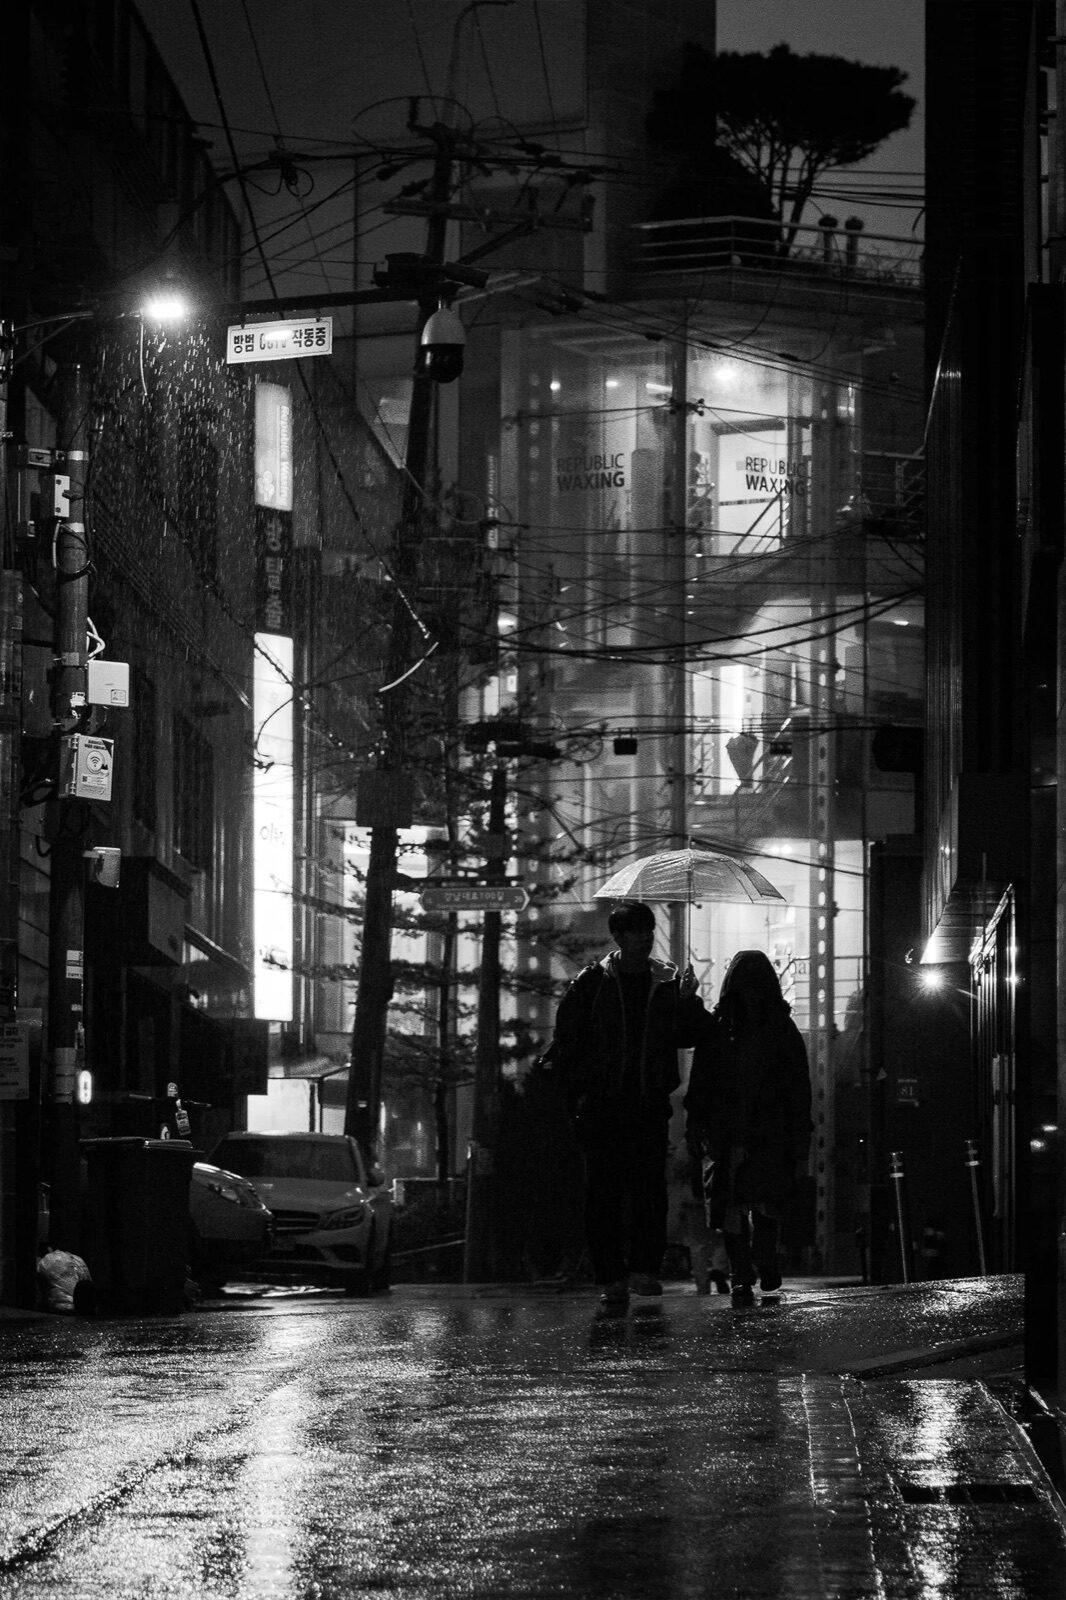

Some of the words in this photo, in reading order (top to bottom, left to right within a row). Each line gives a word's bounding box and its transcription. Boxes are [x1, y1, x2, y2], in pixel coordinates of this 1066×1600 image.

[233, 333, 255, 354] 방범
[292, 326, 326, 348] 작동중
[557, 453, 625, 472] REPUBLIC
[745, 456, 805, 477] REPUBLIC
[557, 471, 625, 491] WAXING
[745, 474, 806, 497] WAXING
